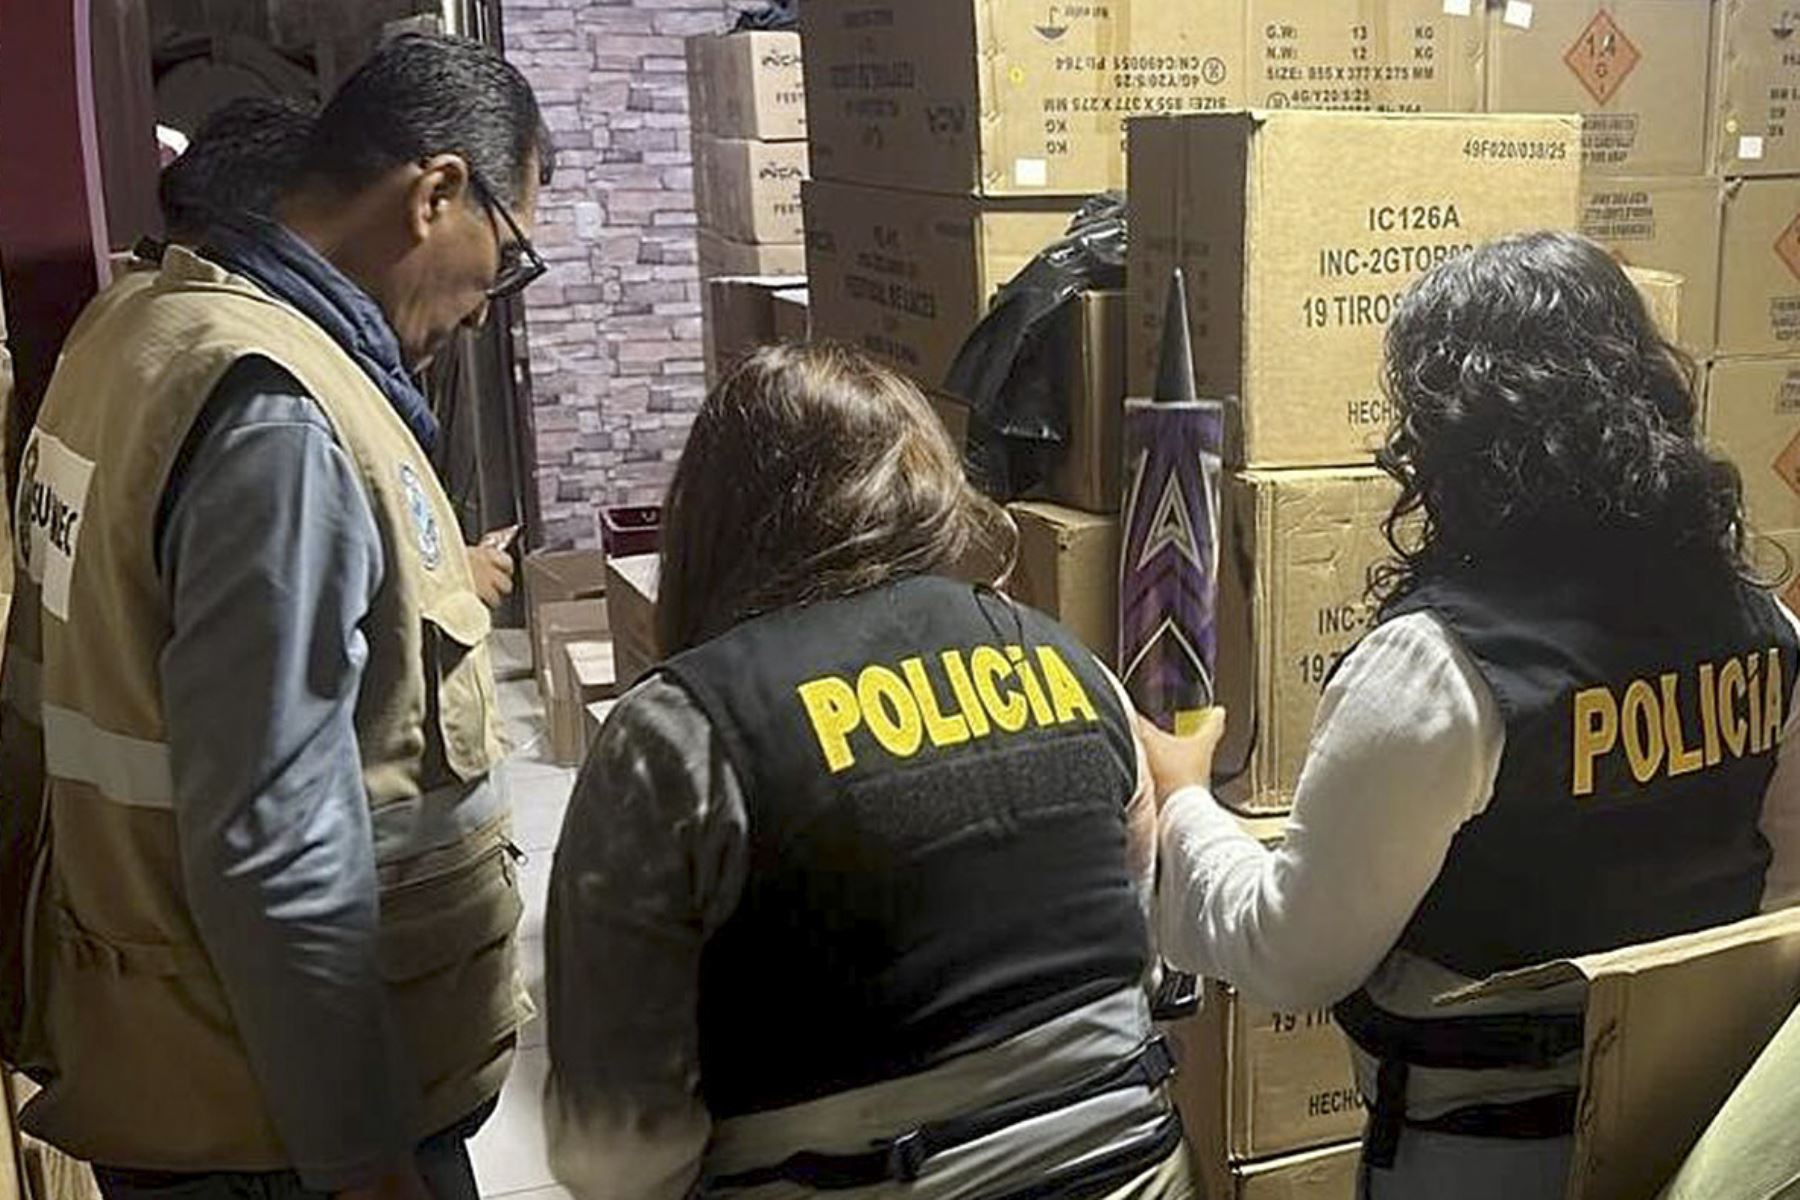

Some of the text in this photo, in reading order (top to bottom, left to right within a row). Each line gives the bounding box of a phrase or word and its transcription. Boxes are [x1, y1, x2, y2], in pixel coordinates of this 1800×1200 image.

[1352, 26, 1367, 40] 13
[1415, 26, 1434, 40] KG
[1352, 47, 1367, 60] 12
[1415, 47, 1433, 60] KG
[1266, 66, 1302, 80] SIZE:
[1046, 119, 1067, 133] KG
[1046, 141, 1068, 154] KG
[1368, 204, 1461, 232] IC126A
[1302, 298, 1328, 328] 19
[1318, 605, 1378, 636] INC-2
[1299, 653, 1324, 685] 19
[797, 644, 1099, 773] POLICÍA
[1572, 647, 1786, 796] POLICÍA
